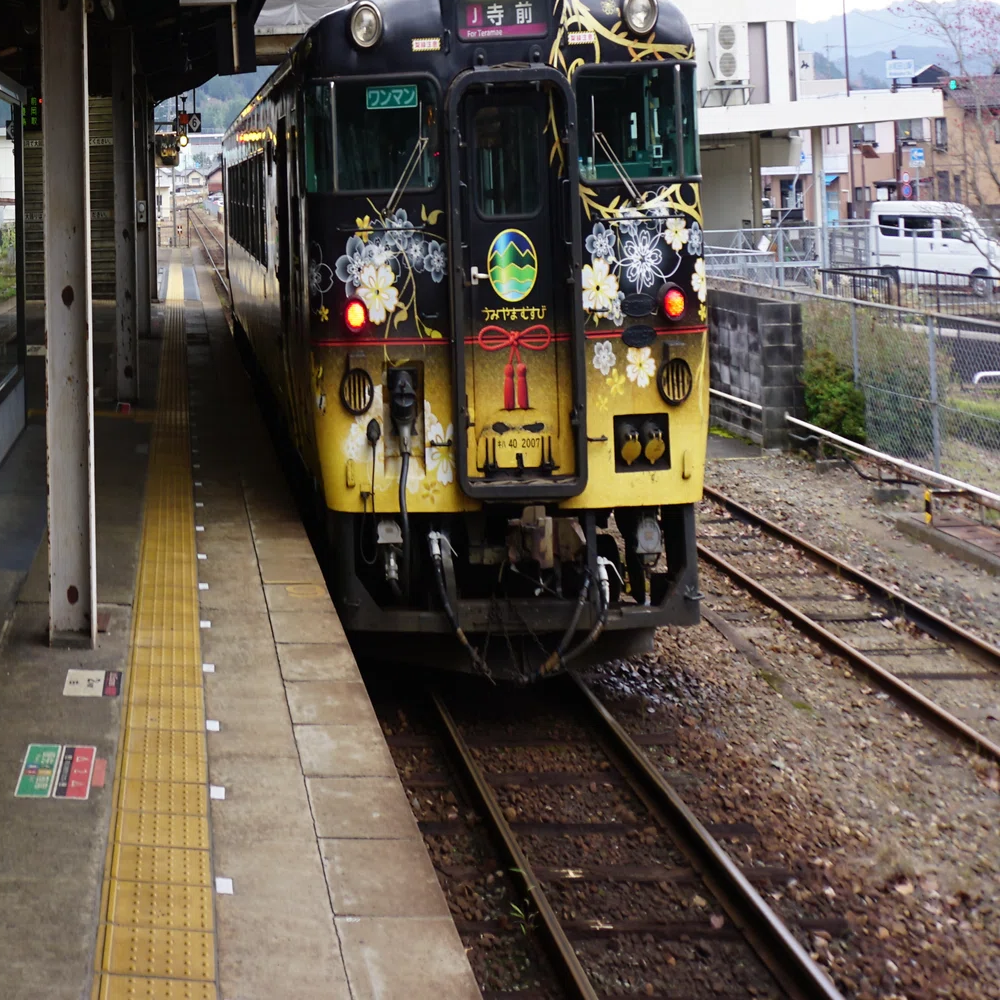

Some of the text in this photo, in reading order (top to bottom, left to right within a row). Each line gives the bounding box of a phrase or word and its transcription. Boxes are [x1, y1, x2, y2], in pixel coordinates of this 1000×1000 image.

[471, 1, 533, 26] J 寺前
[467, 28, 503, 38] For Teramae
[368, 88, 415, 106] ワンマン
[191, 118, 198, 129] 6
[481, 305, 547, 321] うみやまむすび
[508, 438, 518, 448] 40
[521, 437, 540, 448] 2007
